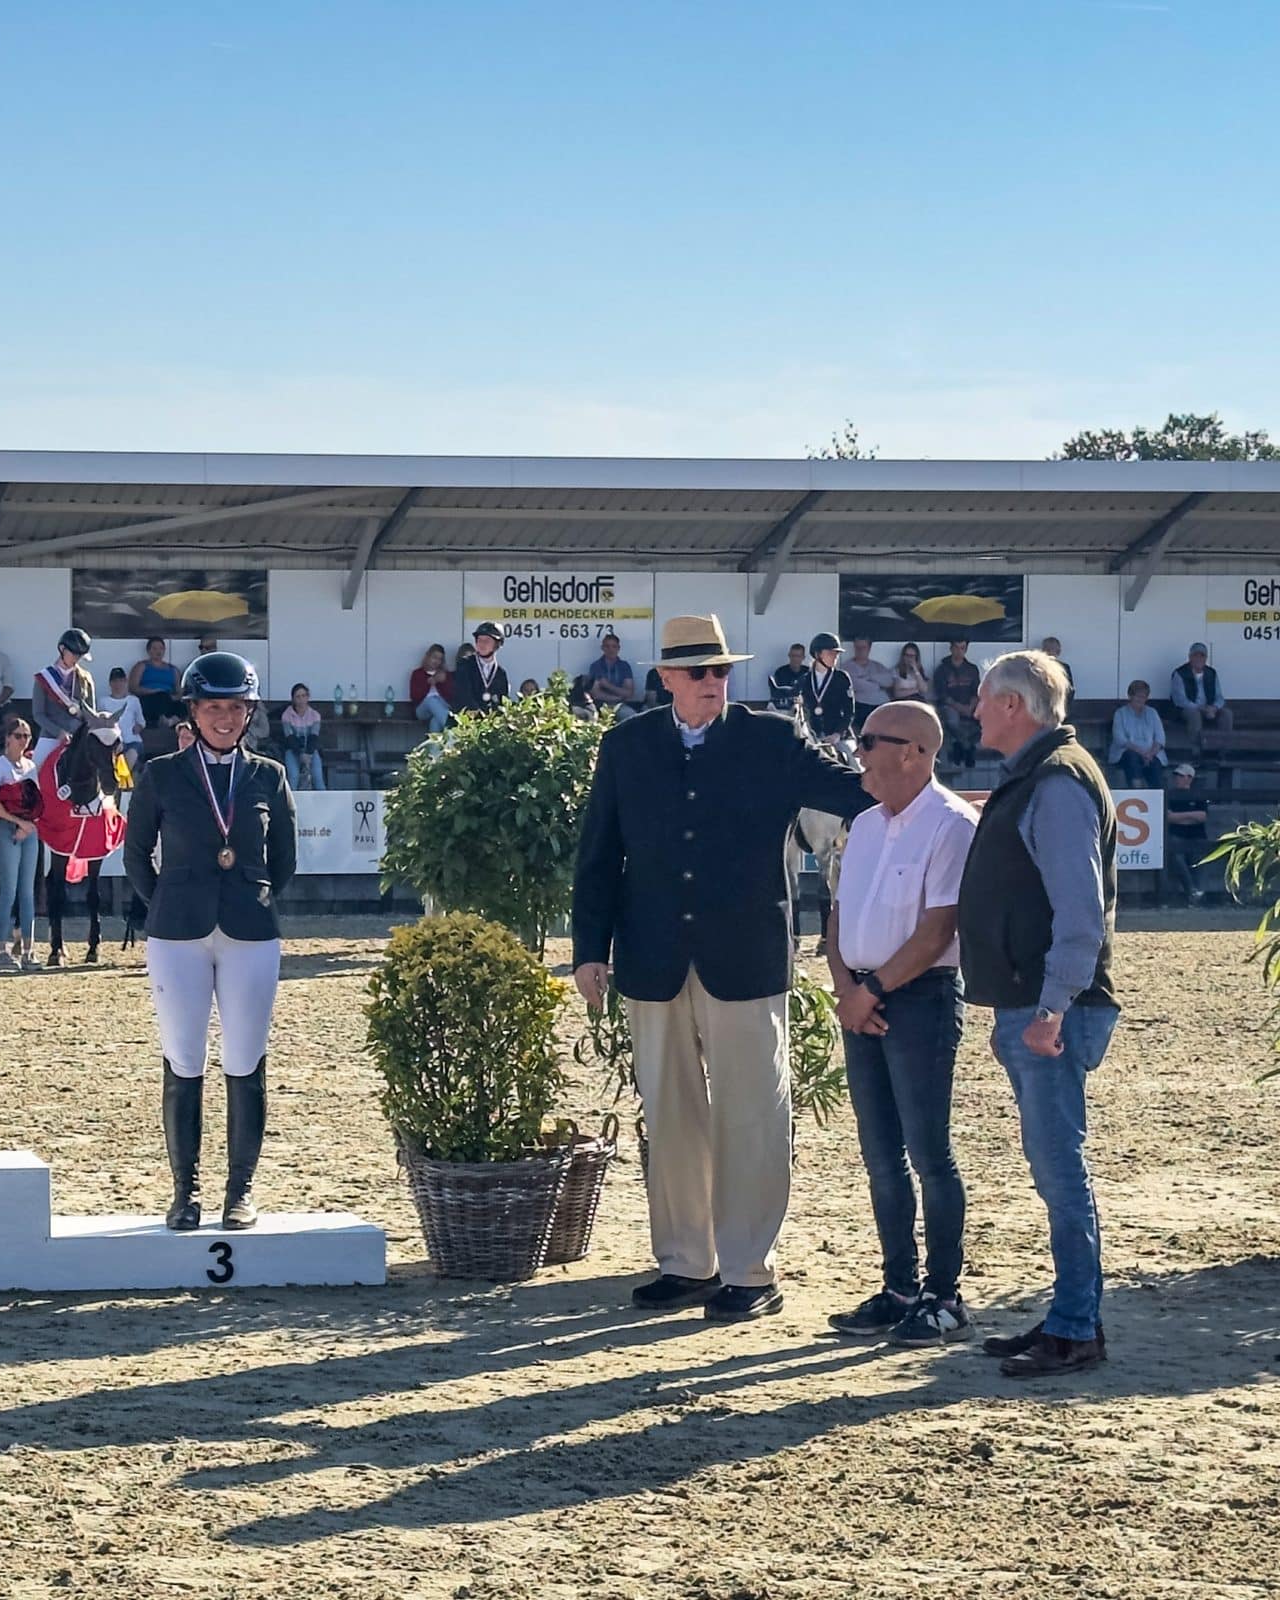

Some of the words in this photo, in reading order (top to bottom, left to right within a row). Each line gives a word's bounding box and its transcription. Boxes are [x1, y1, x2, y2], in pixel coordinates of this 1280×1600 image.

[503, 575, 614, 603] Gehlsdorf
[503, 609, 527, 619] DER
[533, 609, 615, 619] DACHDECKER
[1244, 611, 1267, 621] DER
[504, 624, 541, 638] 0451
[560, 624, 589, 638] 663
[595, 624, 614, 638] 73
[1244, 626, 1280, 640] 0451
[1116, 850, 1150, 864] offe
[206, 1241, 234, 1283] 3
